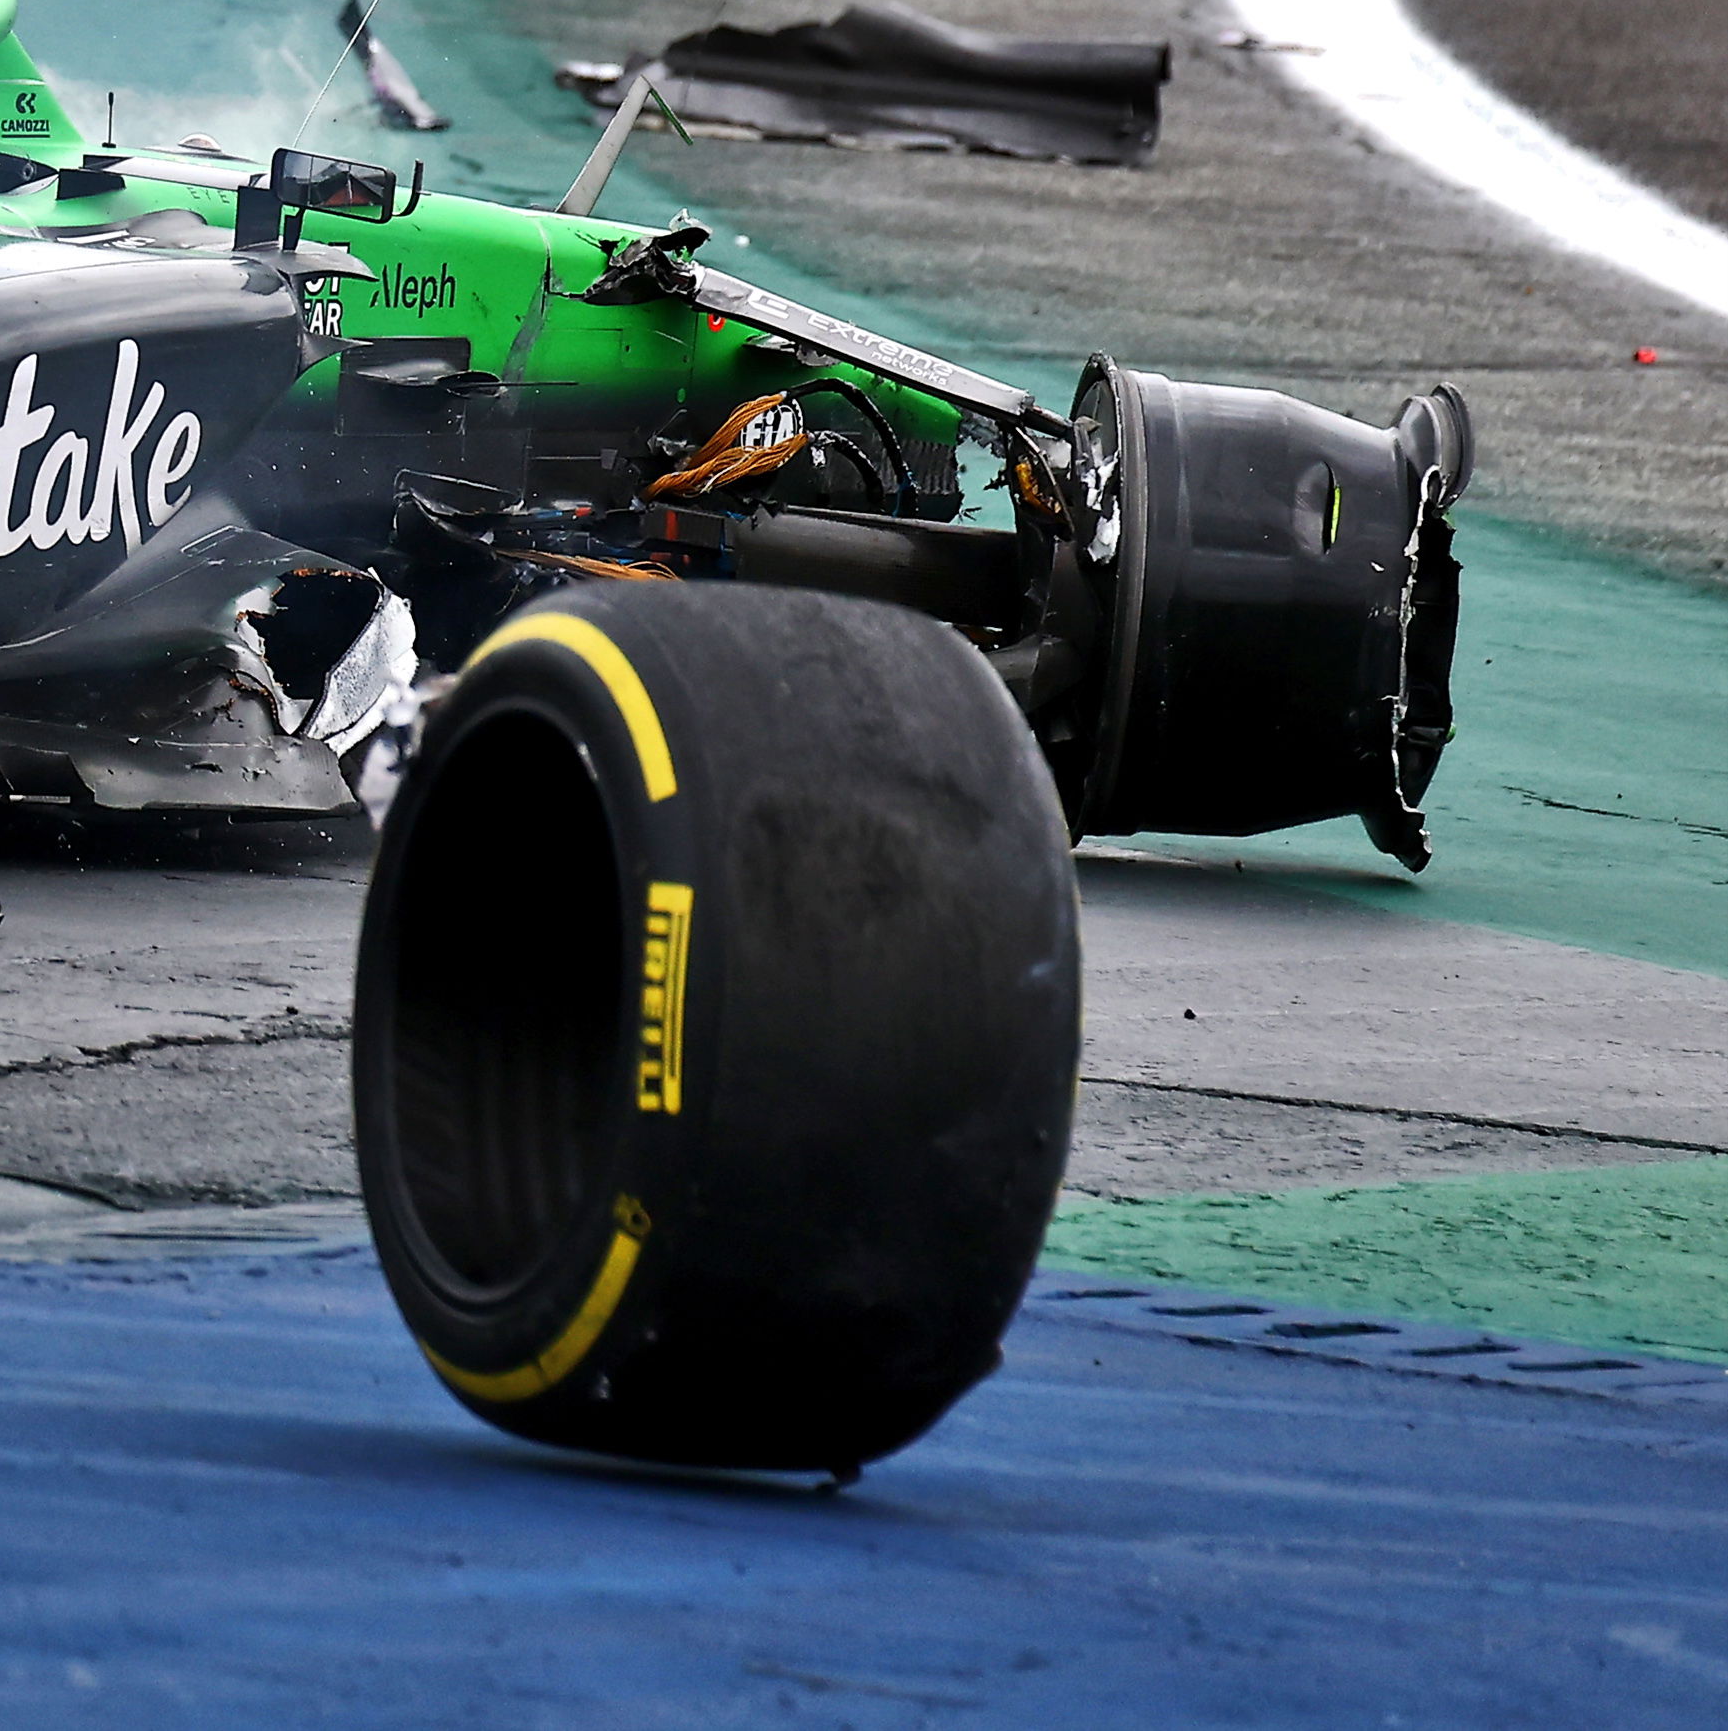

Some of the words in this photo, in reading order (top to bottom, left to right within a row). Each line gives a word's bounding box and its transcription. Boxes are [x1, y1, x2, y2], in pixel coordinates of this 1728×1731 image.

[0, 119, 50, 132] CAMOZZI
[369, 261, 457, 319] Aleph
[807, 312, 956, 378] Extreme
[870, 350, 949, 387] networks
[637, 881, 694, 1115] PIRELLI
